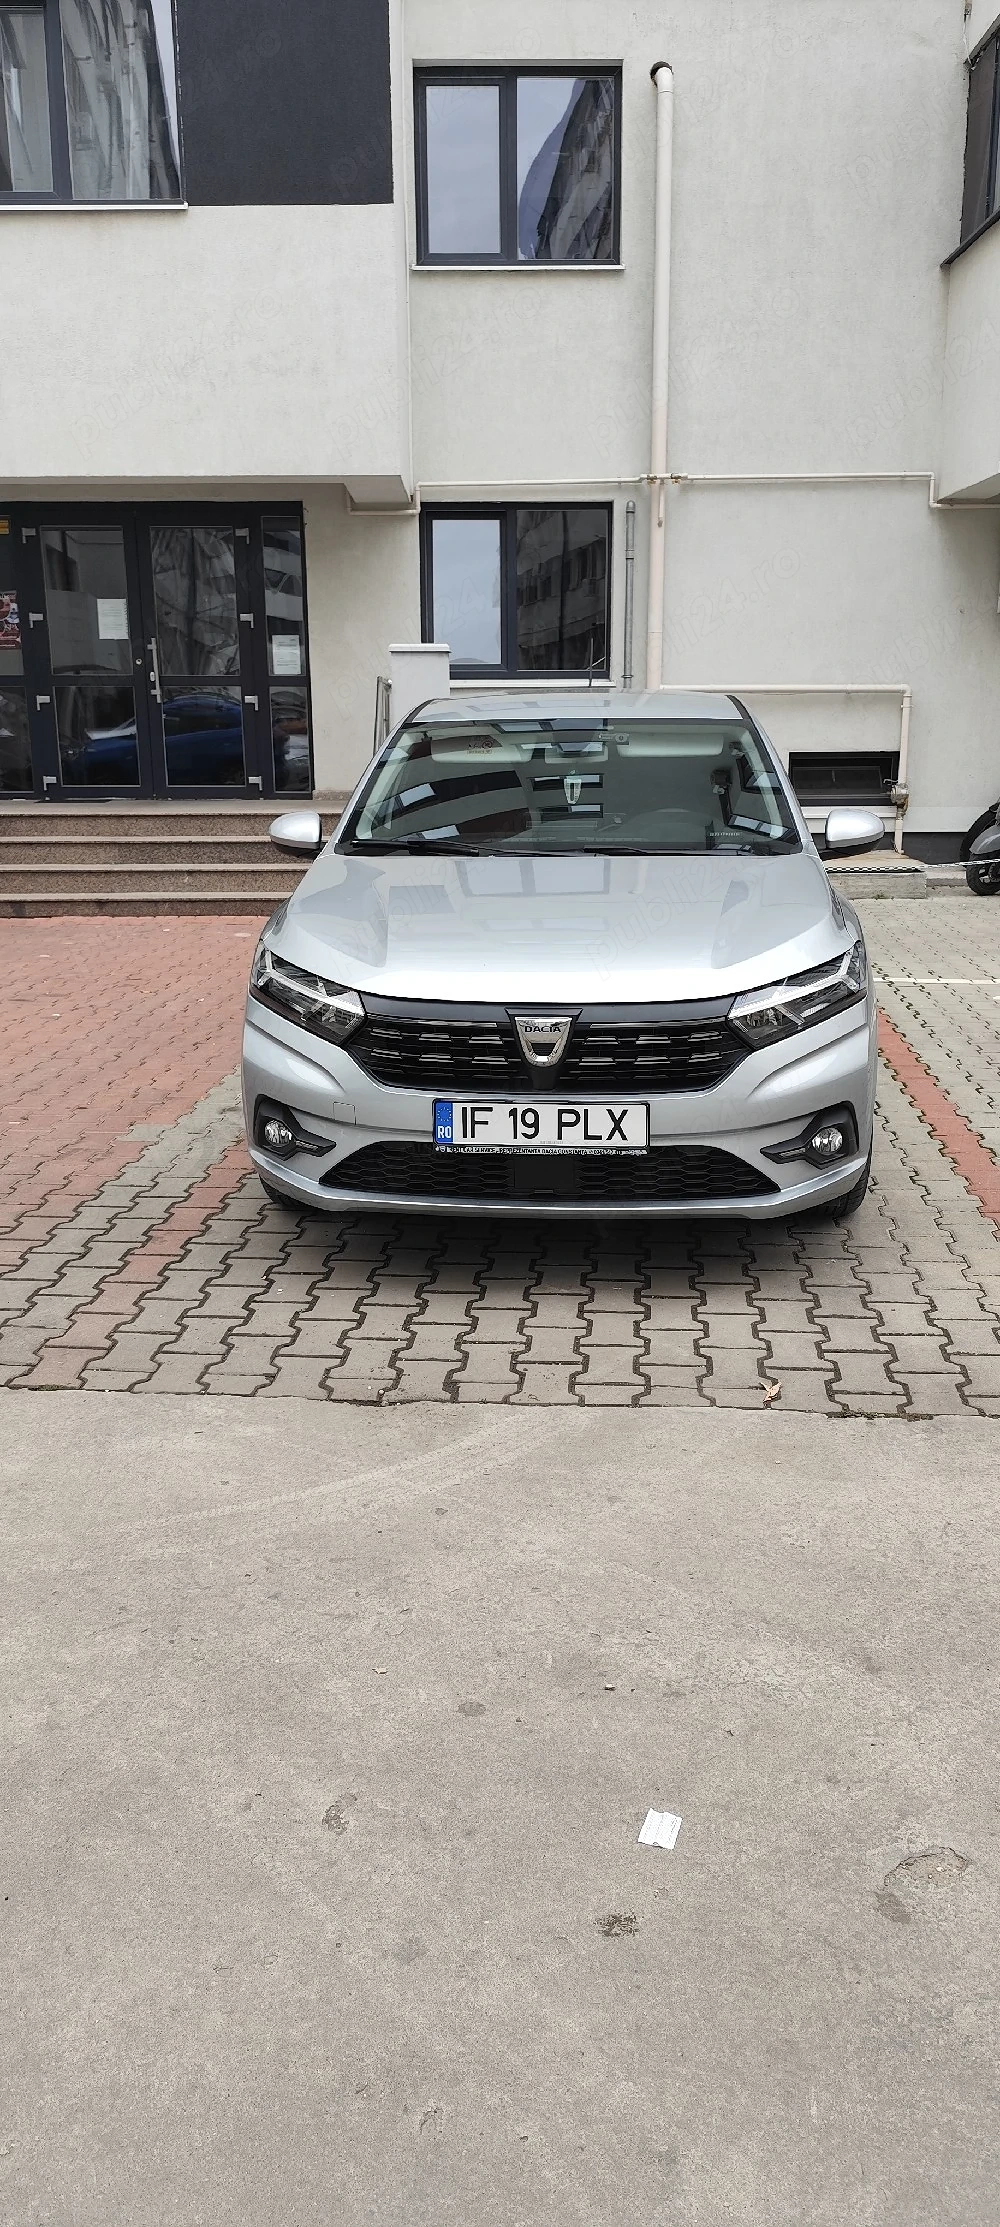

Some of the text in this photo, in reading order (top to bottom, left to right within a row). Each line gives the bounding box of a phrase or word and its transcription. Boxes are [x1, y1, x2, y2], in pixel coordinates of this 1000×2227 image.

[437, 1126, 452, 1139] RO
[461, 1106, 629, 1141] IF 19 PLX
